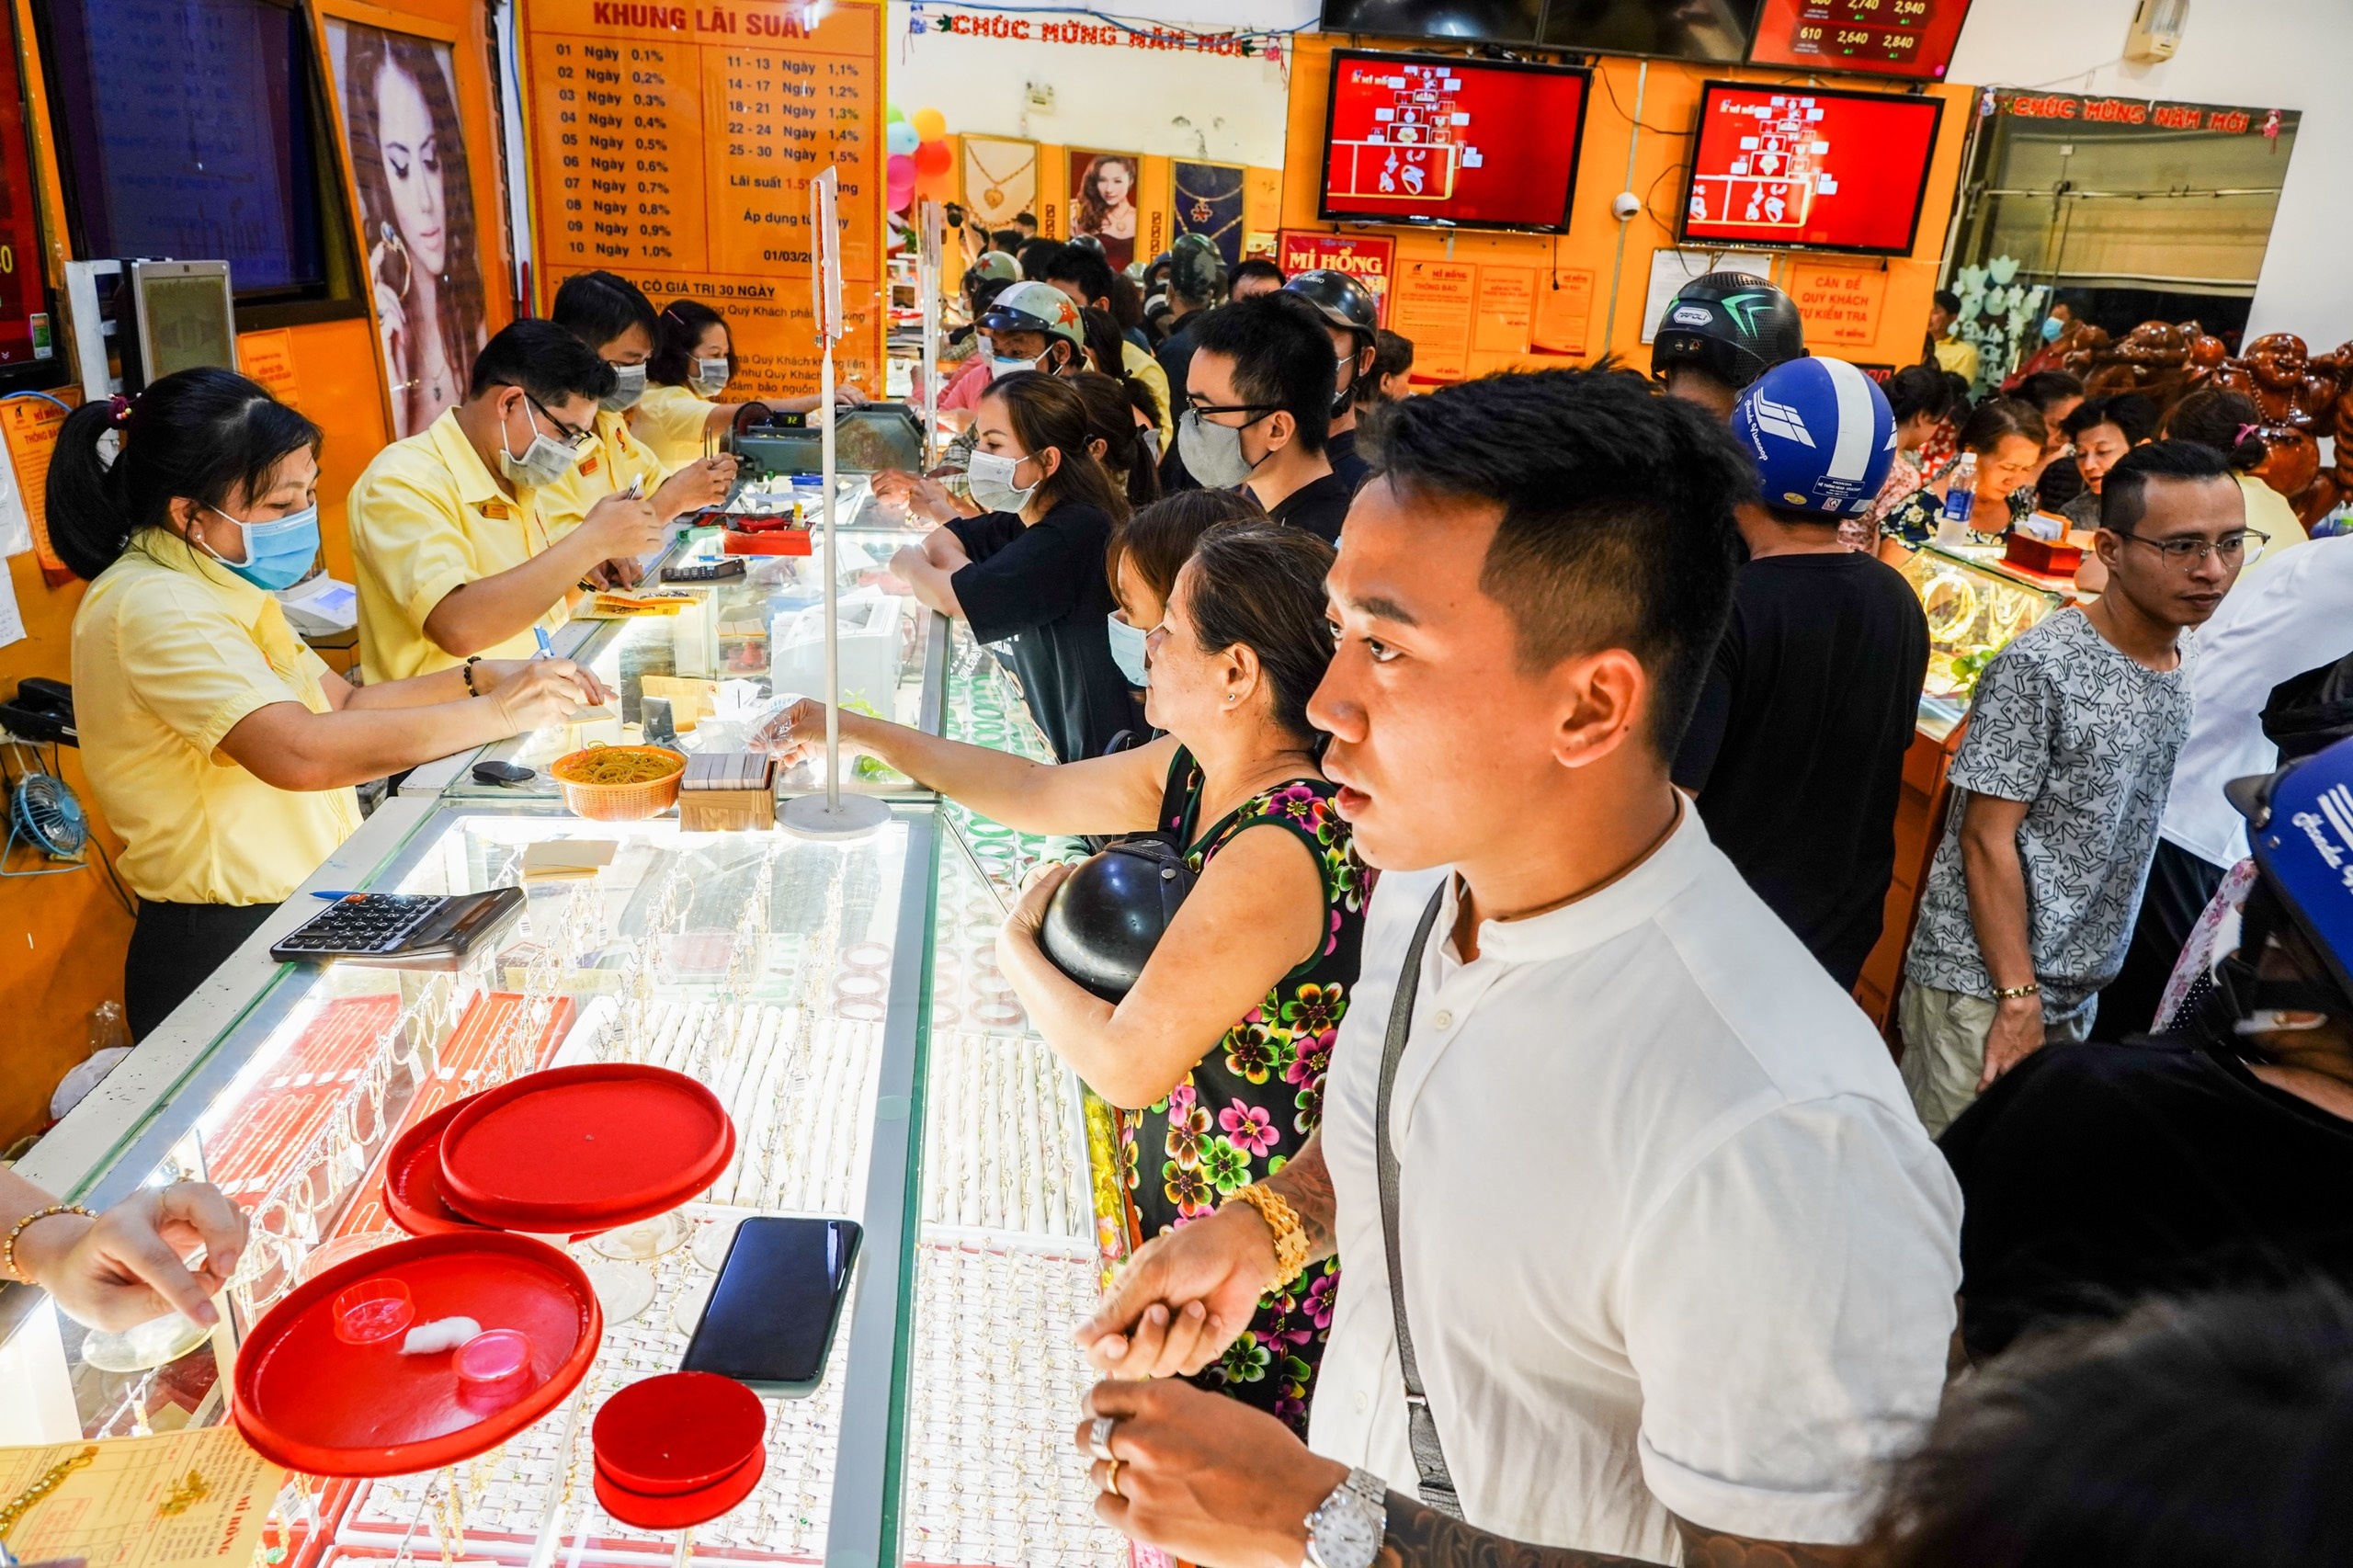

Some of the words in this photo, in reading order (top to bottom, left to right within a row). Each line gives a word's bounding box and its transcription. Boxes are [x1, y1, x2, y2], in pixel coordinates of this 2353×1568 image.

[1893, 1, 1926, 15] 2,940
[594, 2, 688, 30] KHUNG
[696, 6, 735, 34] LÃI
[951, 14, 1029, 40] CHÚC
[1042, 19, 1117, 46] MỪNG
[1800, 27, 1823, 40] 610
[1836, 30, 1869, 44] 2,640
[1882, 35, 1915, 49] 2,840
[556, 44, 571, 55] 01
[585, 46, 619, 62] Ngày
[728, 56, 741, 67] 11
[756, 58, 770, 70] 13
[782, 60, 815, 75] Ngày
[558, 66, 574, 78] 02
[585, 68, 620, 85] Ngày
[728, 79, 743, 89] 14
[756, 80, 770, 91] 17
[559, 89, 574, 101] 03
[587, 90, 621, 107] Ngày
[729, 100, 743, 111] 18
[756, 102, 770, 114] 21
[782, 104, 816, 119] Ngày
[2014, 95, 2076, 119] CHÚC
[2083, 99, 2146, 124] MỪNG
[2154, 107, 2201, 129] NĂM
[2208, 111, 2251, 133] MỚI
[561, 111, 576, 123] 04
[588, 113, 622, 128] Ngày
[728, 122, 744, 133] 22
[756, 124, 771, 135] 24
[783, 126, 816, 141] Ngày
[562, 133, 578, 145] 05
[589, 135, 623, 151] Ngày
[729, 144, 745, 155] 25
[757, 146, 772, 157] 30
[783, 147, 817, 162] Ngày
[563, 155, 579, 167] 06
[591, 157, 625, 173] Ngày
[564, 177, 580, 188] 07
[592, 178, 626, 194] Ngày
[731, 176, 749, 186] Lãi
[755, 176, 781, 188] suất
[566, 199, 582, 210] 08
[594, 199, 627, 215] Ngày
[744, 208, 760, 224] Áp
[766, 212, 798, 227] dụng
[567, 221, 583, 232] 09
[595, 222, 629, 236] Ngày
[570, 242, 585, 253] 10
[596, 242, 630, 257] Ngày
[642, 279, 663, 292] CÓ
[665, 279, 689, 293] GIÁ
[694, 283, 715, 297] TRỊ
[719, 286, 734, 296] 30
[737, 284, 775, 298] NGÀY
[1815, 276, 1838, 289] CẦN
[1846, 275, 1862, 290] ĐỂ
[1802, 292, 1827, 302] QUÝ
[1829, 294, 1869, 306] KHÁCH
[753, 306, 787, 317] Khách
[1815, 305, 1843, 320] KIỂM
[1847, 311, 1867, 322] TRA
[777, 356, 809, 366] Khách
[790, 370, 821, 381] Khách
